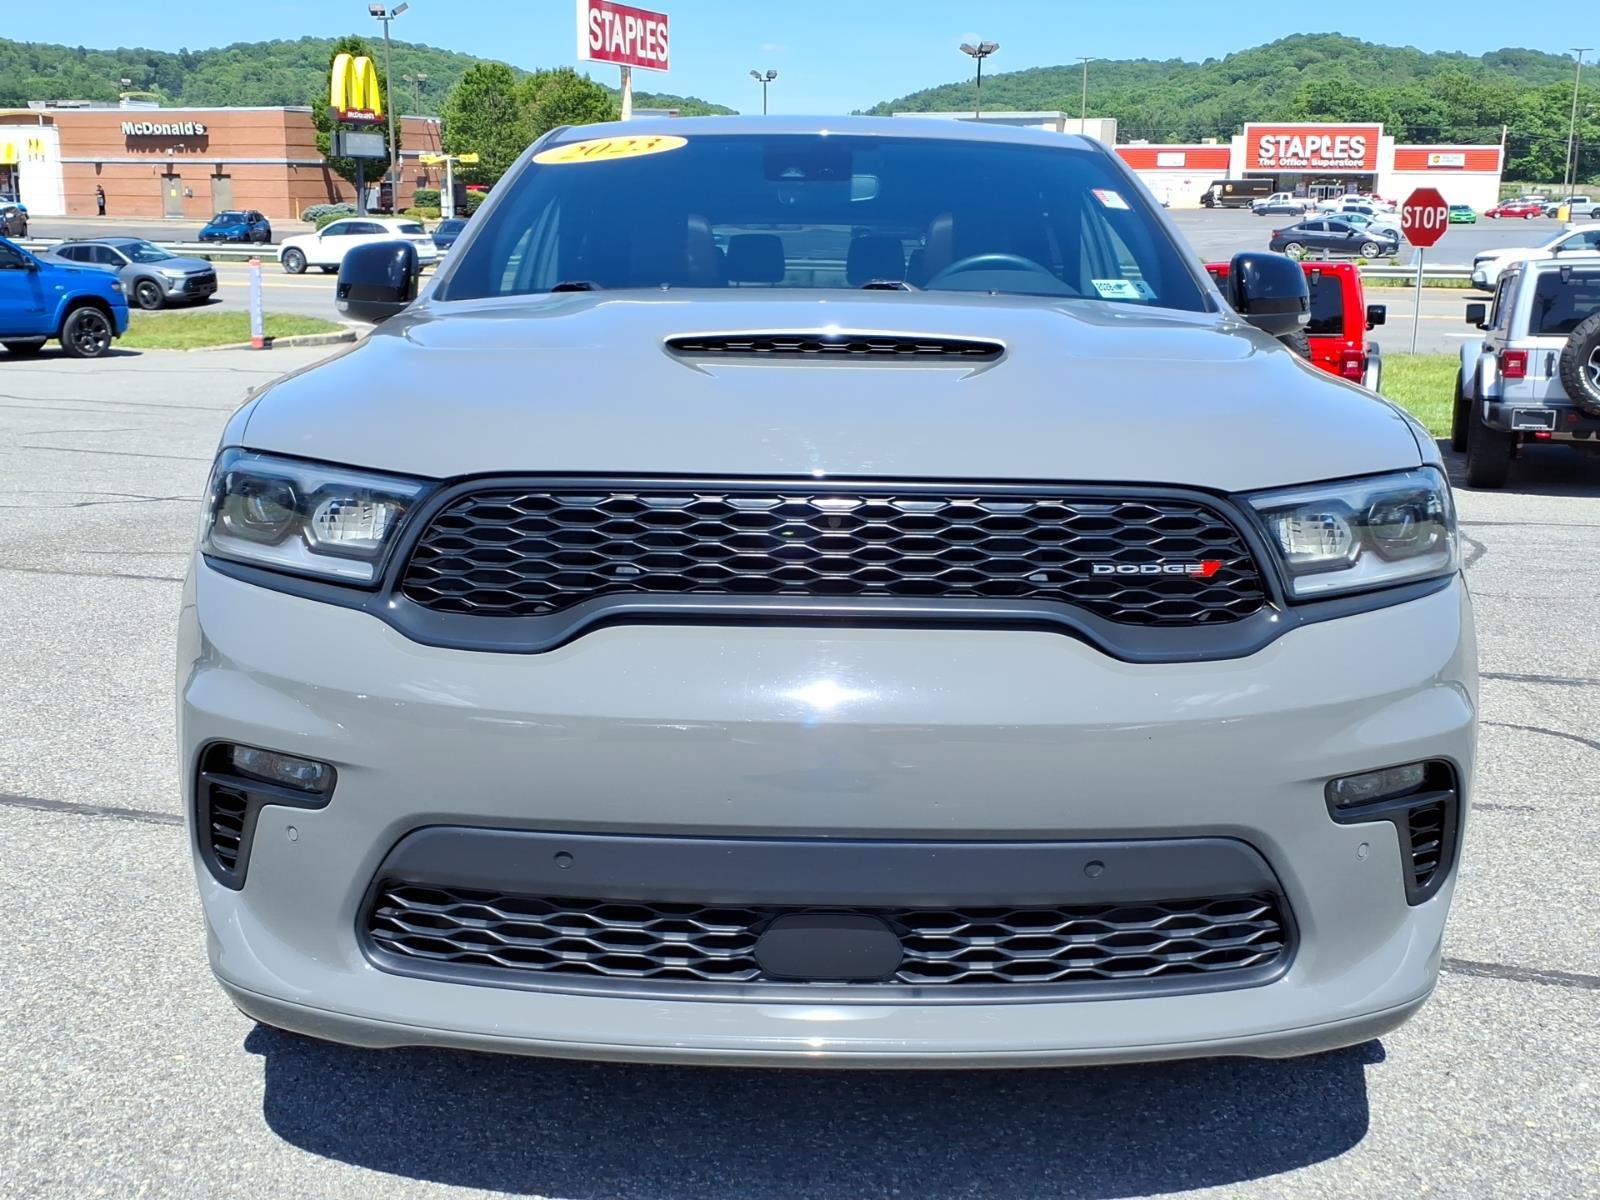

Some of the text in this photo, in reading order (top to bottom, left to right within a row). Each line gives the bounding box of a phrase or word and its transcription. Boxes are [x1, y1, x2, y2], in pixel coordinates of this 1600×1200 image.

[589, 8, 668, 62] STAPLES
[121, 121, 205, 135] McDonald's
[1259, 135, 1366, 159] STAPLES
[1258, 158, 1364, 167] The Office Superstore
[1402, 206, 1447, 229] STOP
[1093, 563, 1204, 574] DODGE
